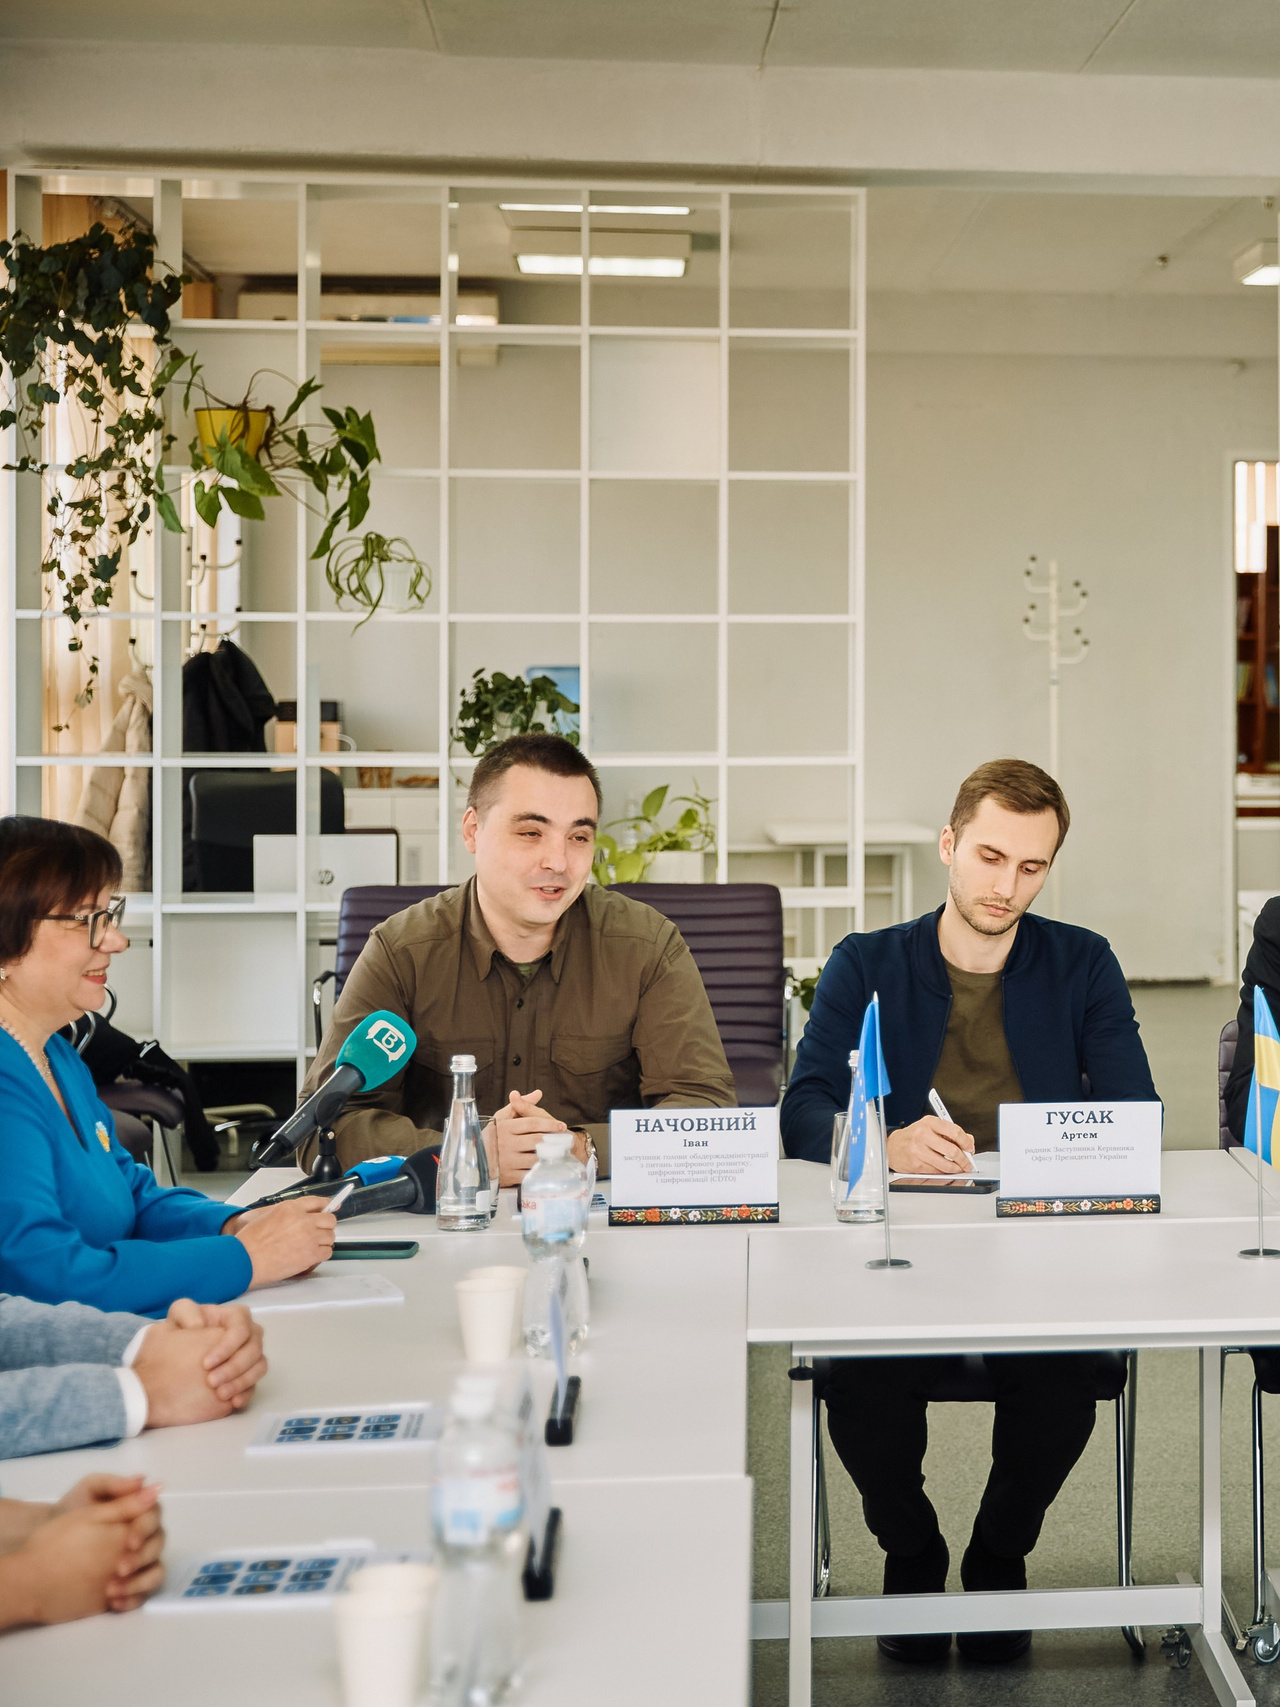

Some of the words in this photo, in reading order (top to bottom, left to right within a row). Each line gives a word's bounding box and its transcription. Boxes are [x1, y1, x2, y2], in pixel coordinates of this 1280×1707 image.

[635, 1112, 757, 1133] НАЧОВНИЙ
[1046, 1110, 1114, 1125] ГУСАК
[1061, 1131, 1098, 1141] Артем
[683, 1138, 709, 1148] Іван
